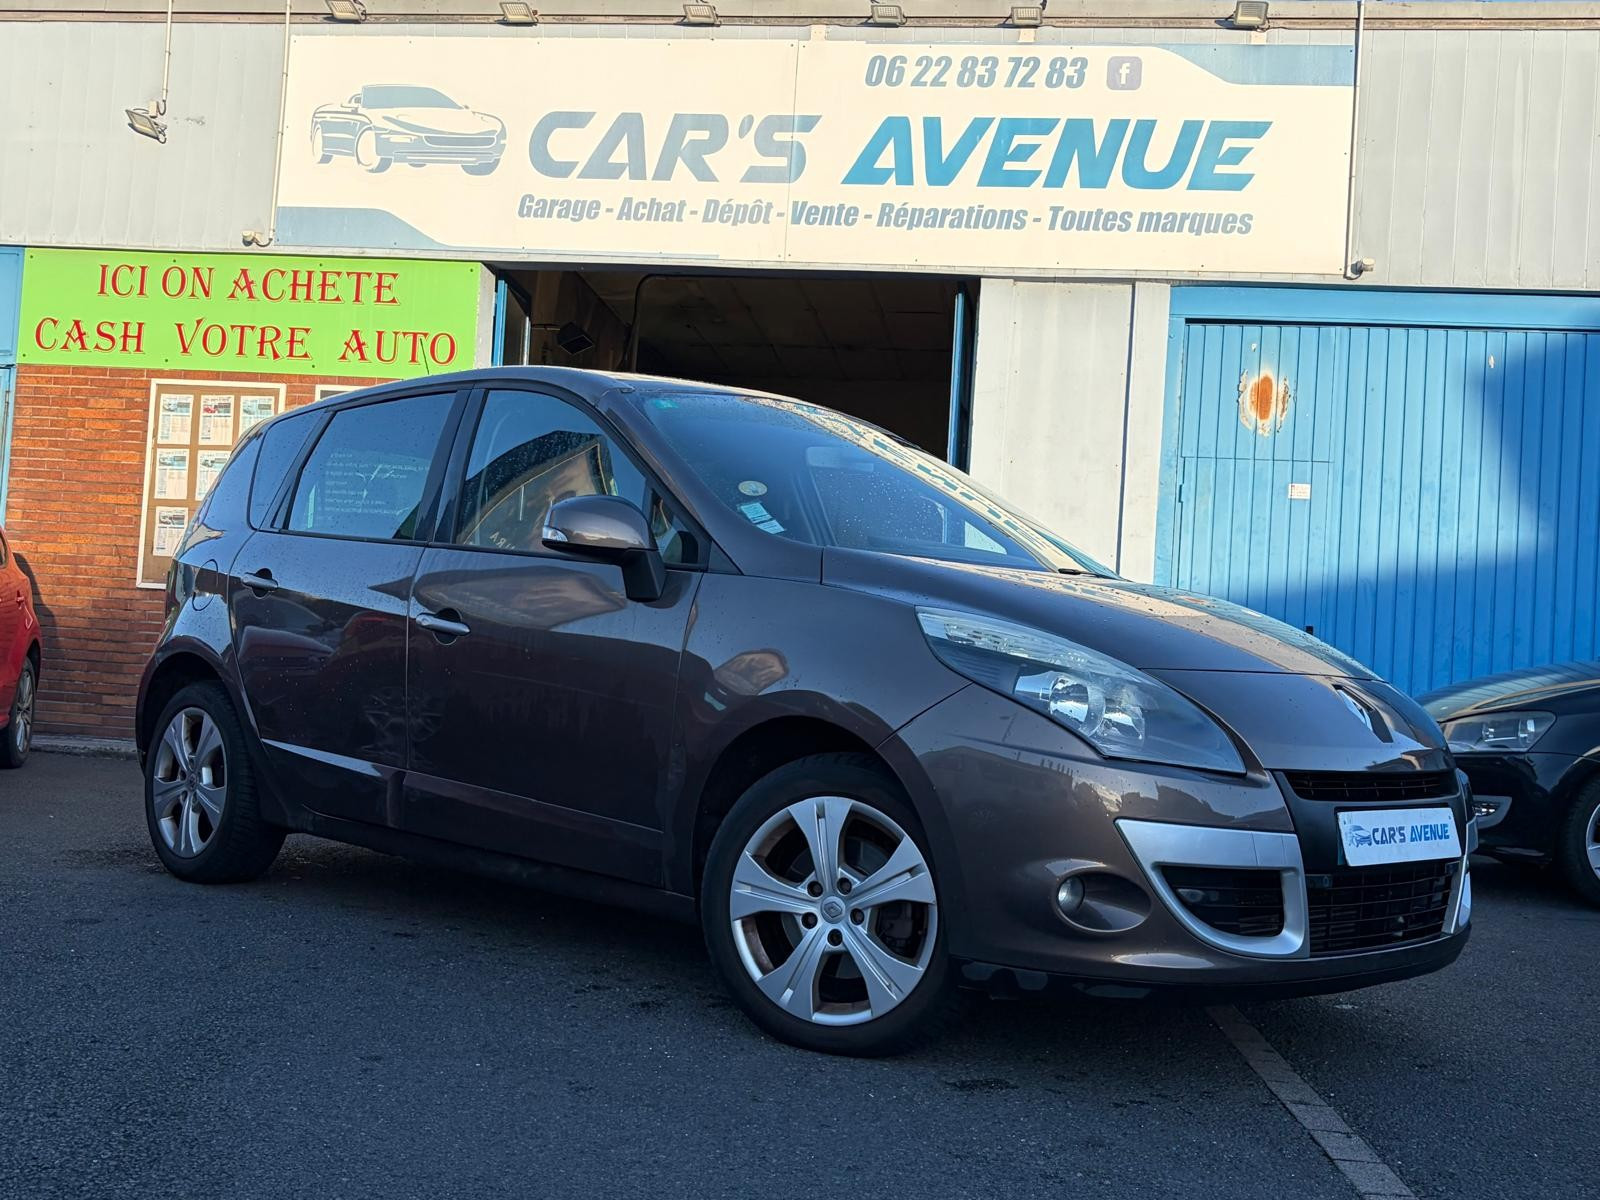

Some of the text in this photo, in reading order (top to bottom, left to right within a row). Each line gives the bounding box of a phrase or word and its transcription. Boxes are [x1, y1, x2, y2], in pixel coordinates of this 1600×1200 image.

[864, 55, 1089, 89] 06 22 83 72 83
[528, 111, 1274, 192] CAR'S AVENUE
[517, 194, 1255, 236] Garage Achat Dépôt Vente Réparations Toutes marques
[98, 264, 399, 306] ICI ON ACHETE
[34, 317, 458, 366] CASH VOTRE AUTO
[1371, 823, 1450, 846] CAR'S AVENUE
